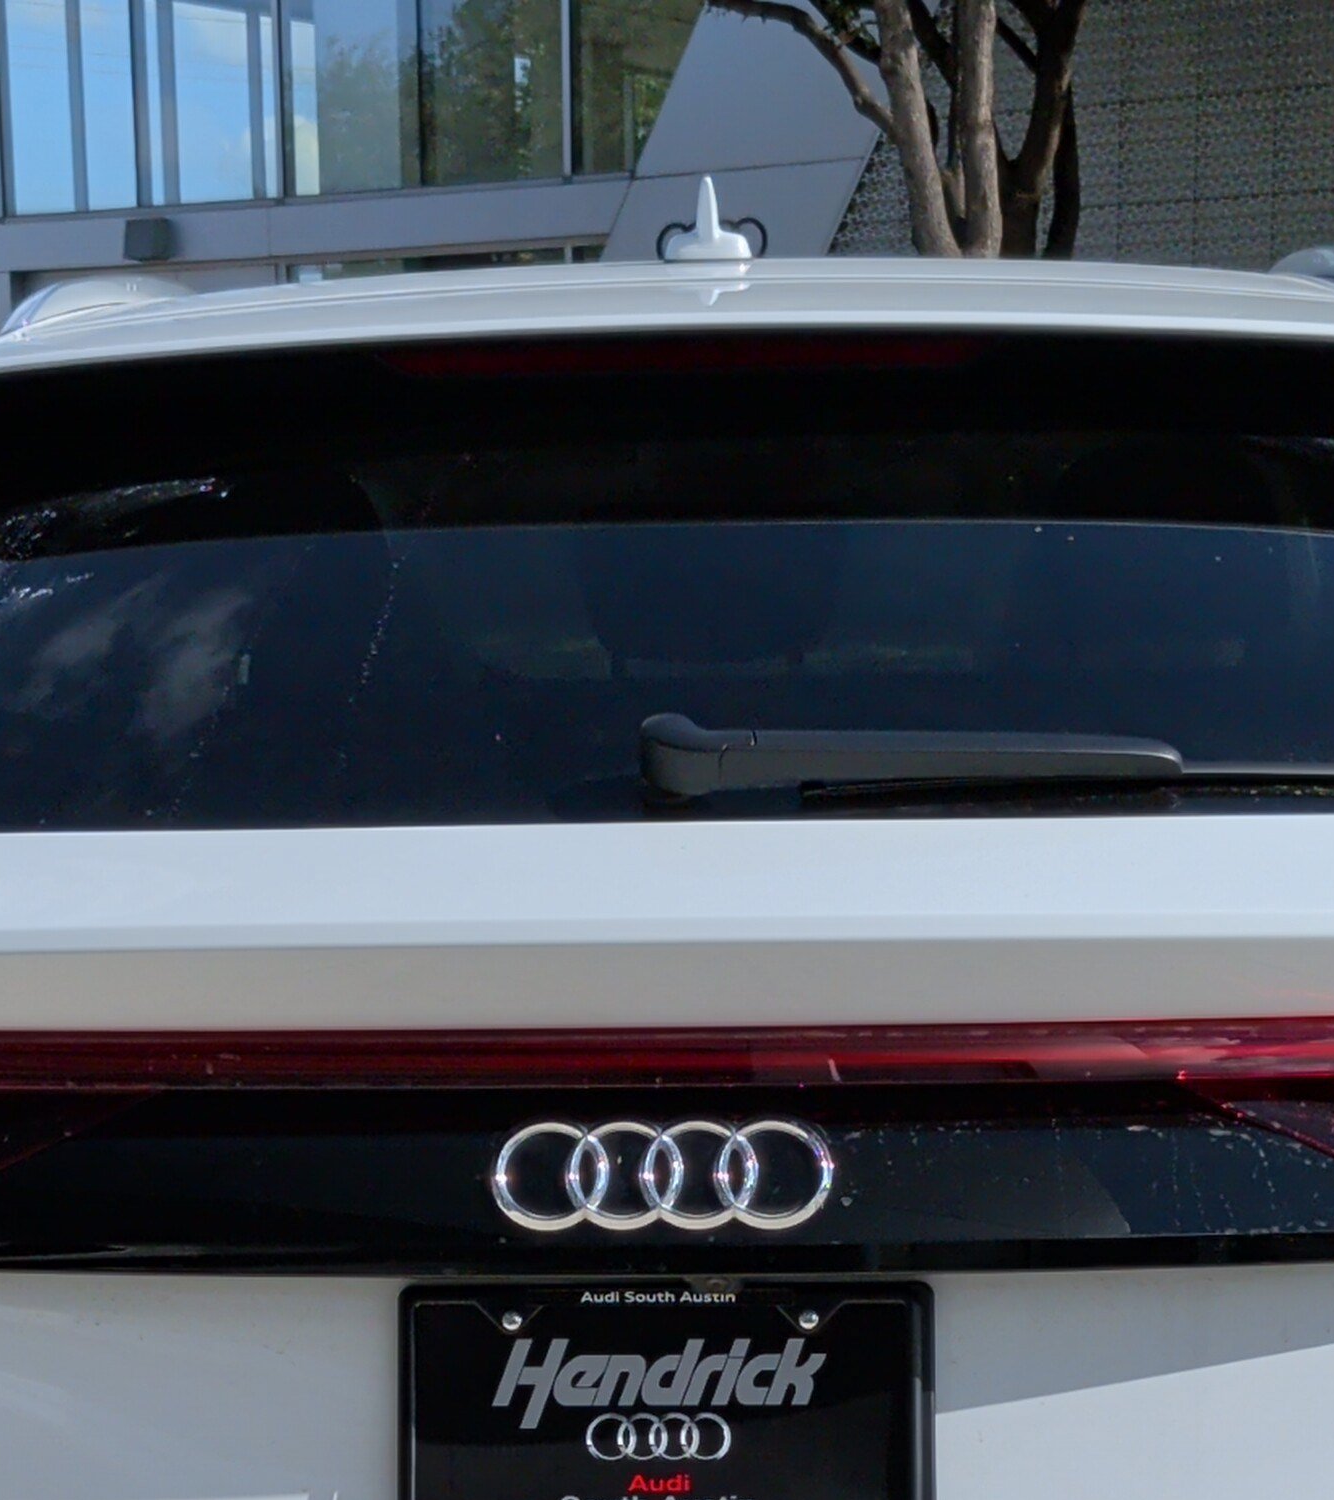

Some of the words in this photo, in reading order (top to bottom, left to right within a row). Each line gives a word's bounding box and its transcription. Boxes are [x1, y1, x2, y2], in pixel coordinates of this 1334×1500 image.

[580, 1290, 620, 1304] Audi
[624, 1290, 675, 1304] South
[679, 1290, 736, 1304] Austin
[491, 1337, 828, 1430] Hendrick
[627, 1473, 692, 1493] Audi
